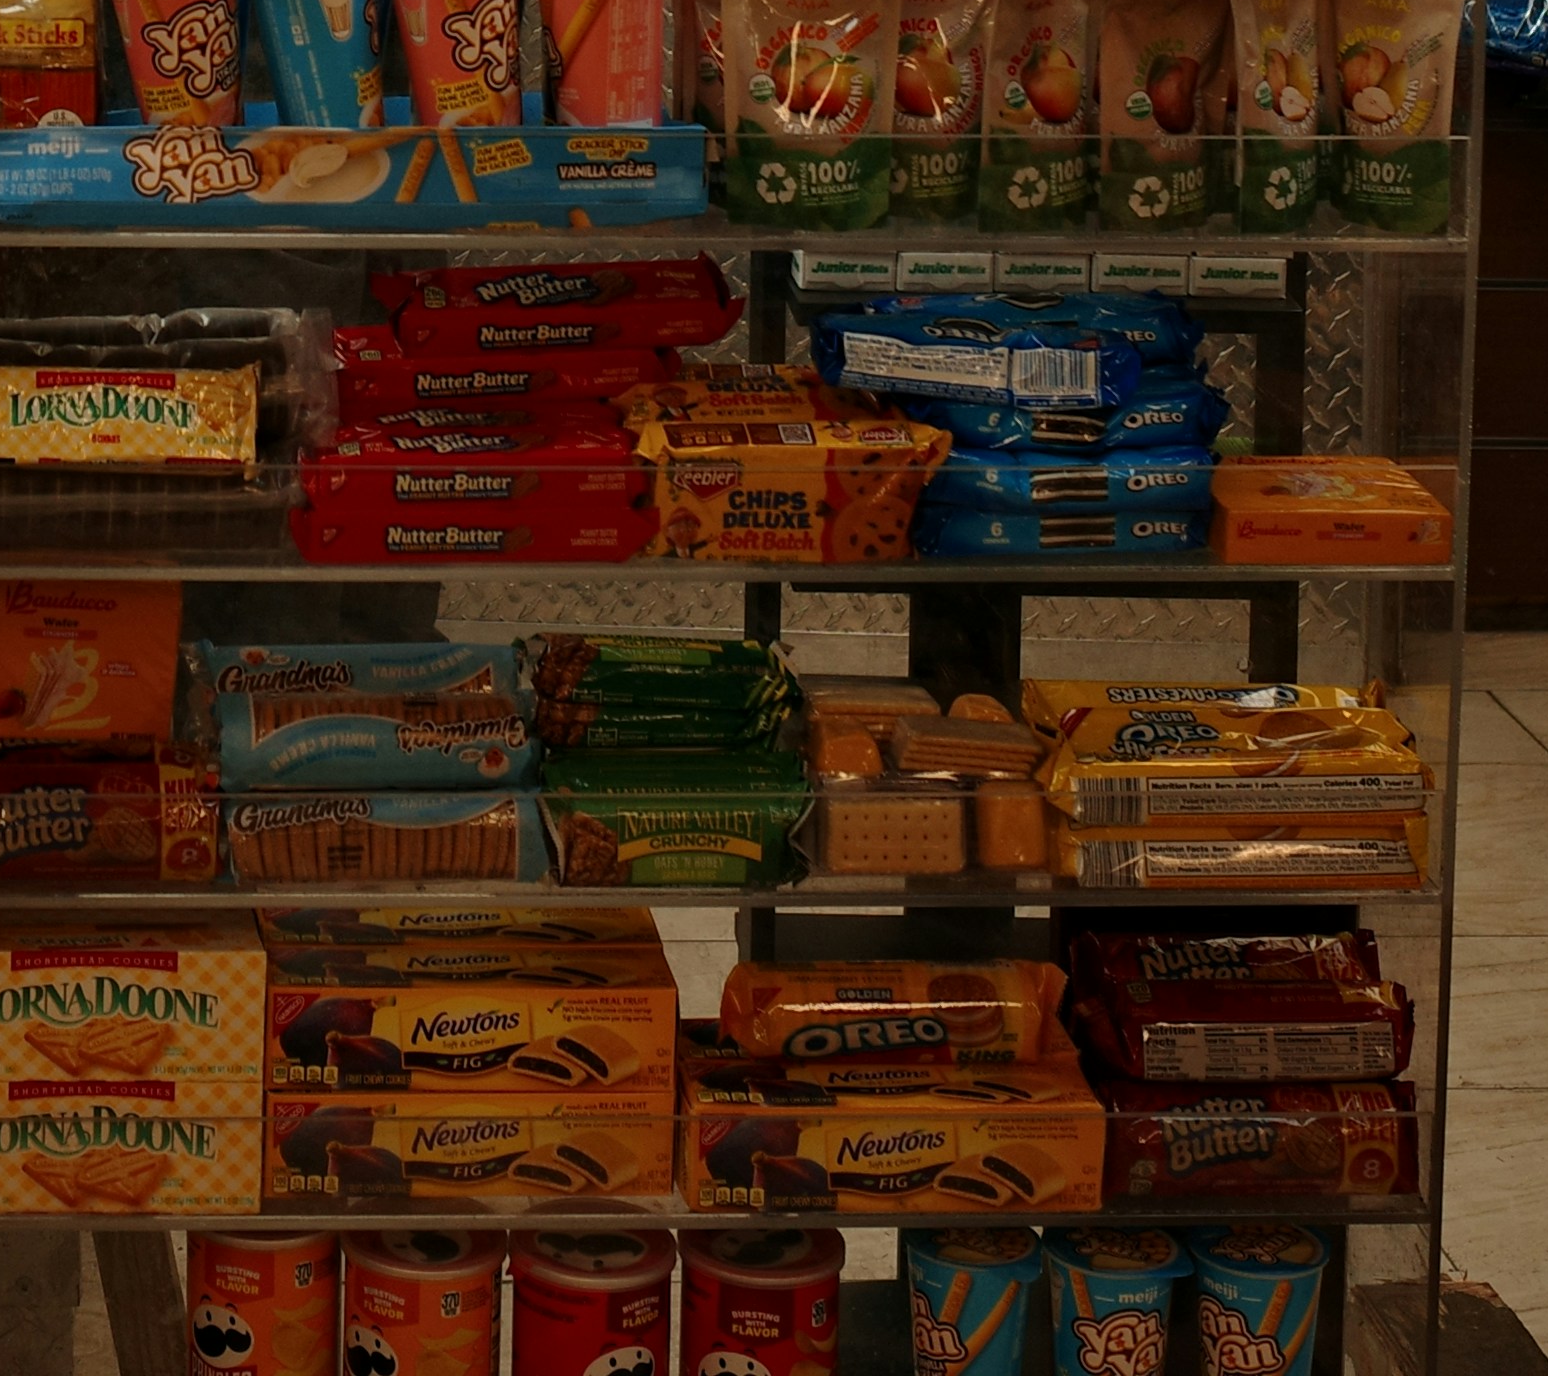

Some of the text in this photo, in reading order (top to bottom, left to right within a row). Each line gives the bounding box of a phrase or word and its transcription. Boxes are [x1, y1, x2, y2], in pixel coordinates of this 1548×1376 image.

[12, 26, 79, 47] Sticks
[27, 136, 82, 159] meiji
[807, 160, 863, 185] 100%
[812, 260, 889, 275] Junior Mints
[1124, 408, 1185, 430] OREO
[1126, 470, 1188, 493] OREO
[722, 508, 811, 530] DELUXE
[6, 582, 118, 617] Bauducco
[216, 661, 352, 697] Grandma's
[649, 835, 731, 851] CRUNCHY
[14, 953, 177, 971] SHORTBREAD COOKIES
[92, 977, 219, 1030] DOONE
[837, 989, 890, 1001] GOLDEN
[411, 1008, 522, 1046] Newtons
[785, 1018, 948, 1059] OREO
[452, 1055, 484, 1070] FIG
[411, 1120, 521, 1153] Newtons
[836, 1128, 946, 1167] Newtons
[452, 1165, 484, 1179] FIG
[877, 1175, 909, 1191] FIG
